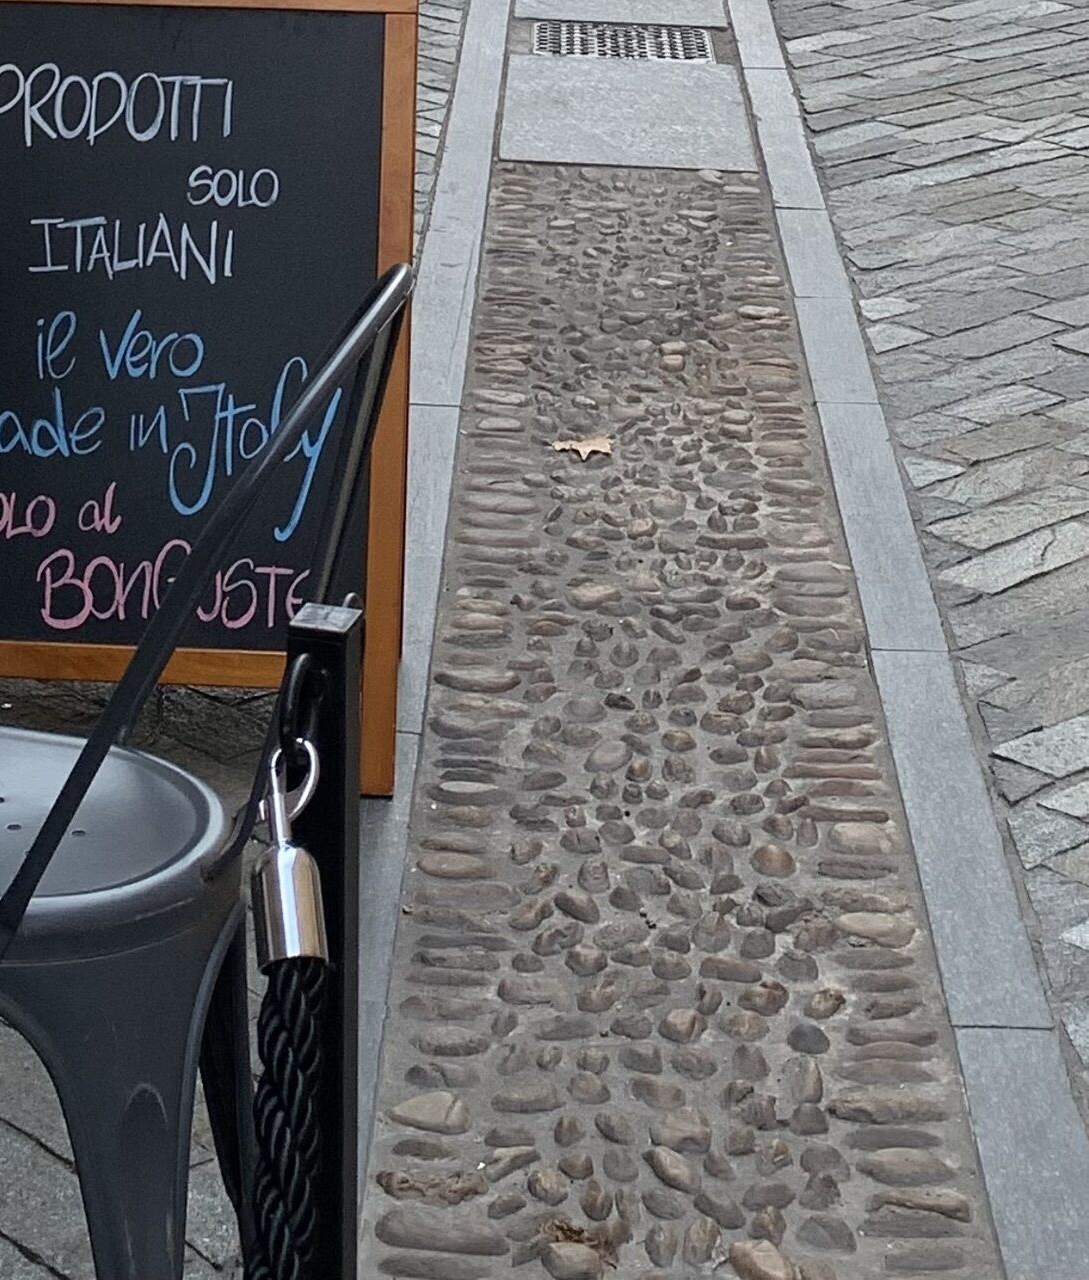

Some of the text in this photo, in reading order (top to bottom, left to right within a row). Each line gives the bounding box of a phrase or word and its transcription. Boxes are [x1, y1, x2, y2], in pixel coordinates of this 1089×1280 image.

[187, 164, 280, 208] SOLO
[27, 212, 234, 285] ITALIANI
[36, 309, 77, 380] il
[130, 406, 168, 456] in
[77, 481, 122, 535] al
